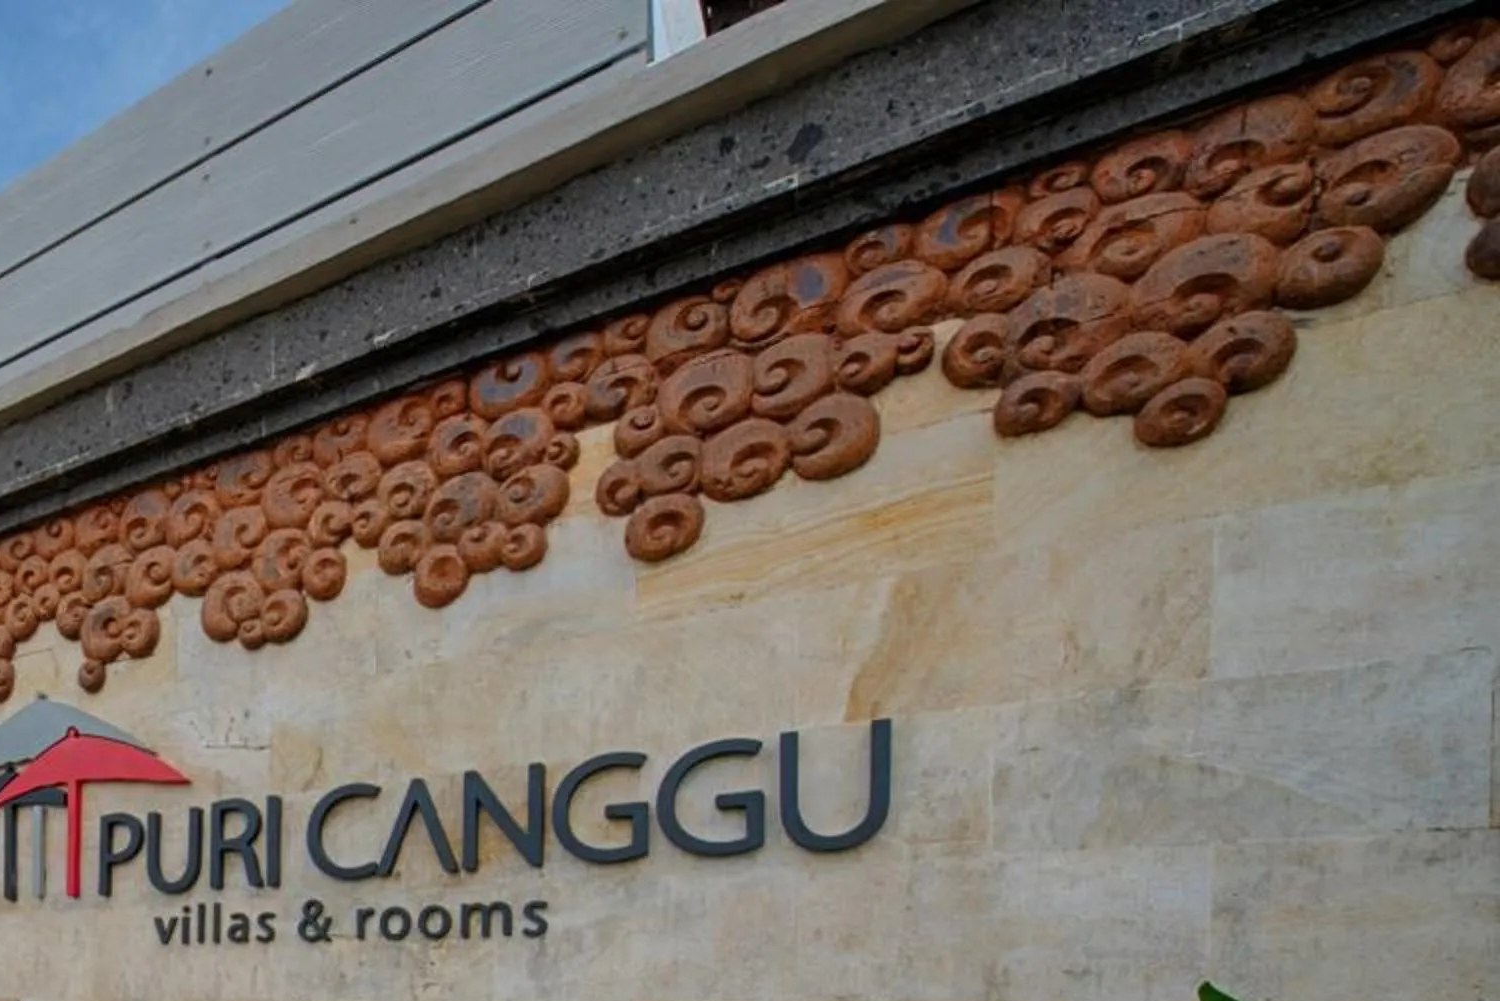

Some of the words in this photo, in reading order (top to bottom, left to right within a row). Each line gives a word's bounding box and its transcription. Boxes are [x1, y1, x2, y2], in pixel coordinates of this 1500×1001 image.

[98, 795, 282, 898] PURI
[306, 718, 891, 881] CANGGU
[154, 902, 277, 945] villas
[297, 899, 332, 943] &
[355, 899, 549, 943] rooms
